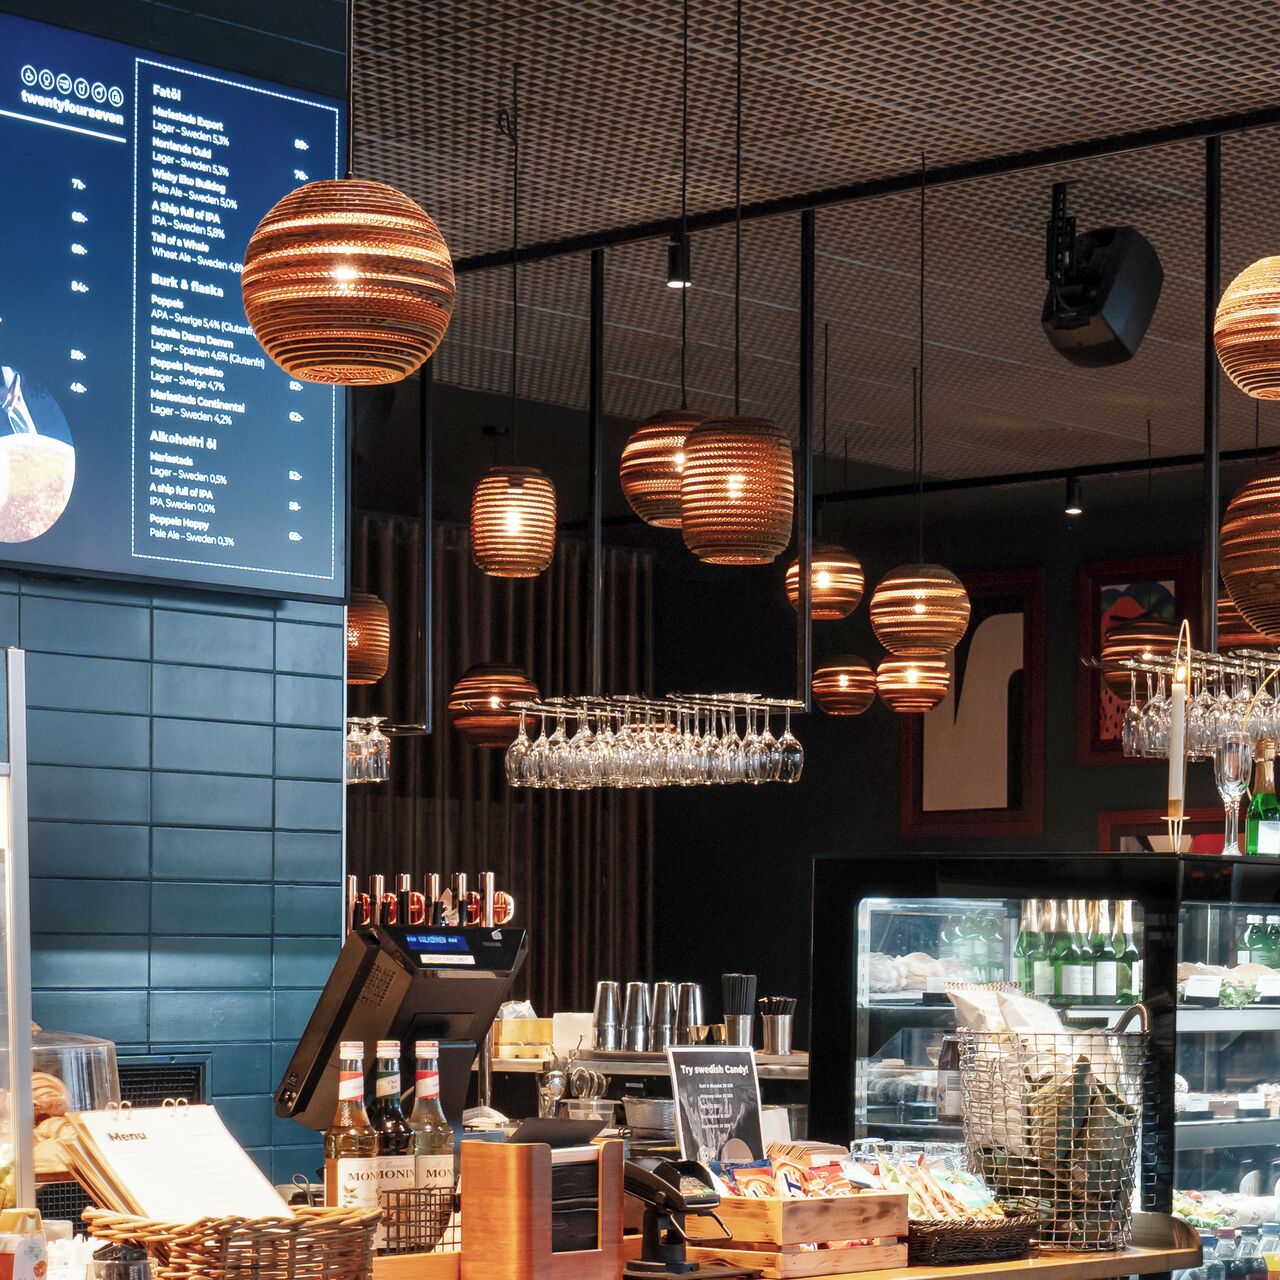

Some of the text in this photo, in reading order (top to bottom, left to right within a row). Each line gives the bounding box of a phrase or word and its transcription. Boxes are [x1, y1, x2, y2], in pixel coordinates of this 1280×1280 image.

[153, 84, 181, 101] Fatöl
[21, 90, 124, 125] twentyfourseven
[153, 120, 229, 146] Lager Sweden 5,3%
[153, 151, 229, 176] Lager Sweden 5,3%
[153, 182, 237, 209] Pale Ale Sweden 5,0%
[152, 215, 225, 239] IPA Sweden 5,8%
[152, 273, 223, 297] Burk & flaska
[151, 309, 220, 330] APA Sverige 5,4%
[151, 403, 232, 425] Lager Sweden 4,2%
[150, 430, 216, 450] Alkoholfri öl
[150, 466, 227, 484] Lager Sweden 0,5%
[150, 528, 234, 546] Pale Ale Sweden 0,3%
[680, 1064, 749, 1076] Try swedish Candy!
[108, 1132, 147, 1143] Menu
